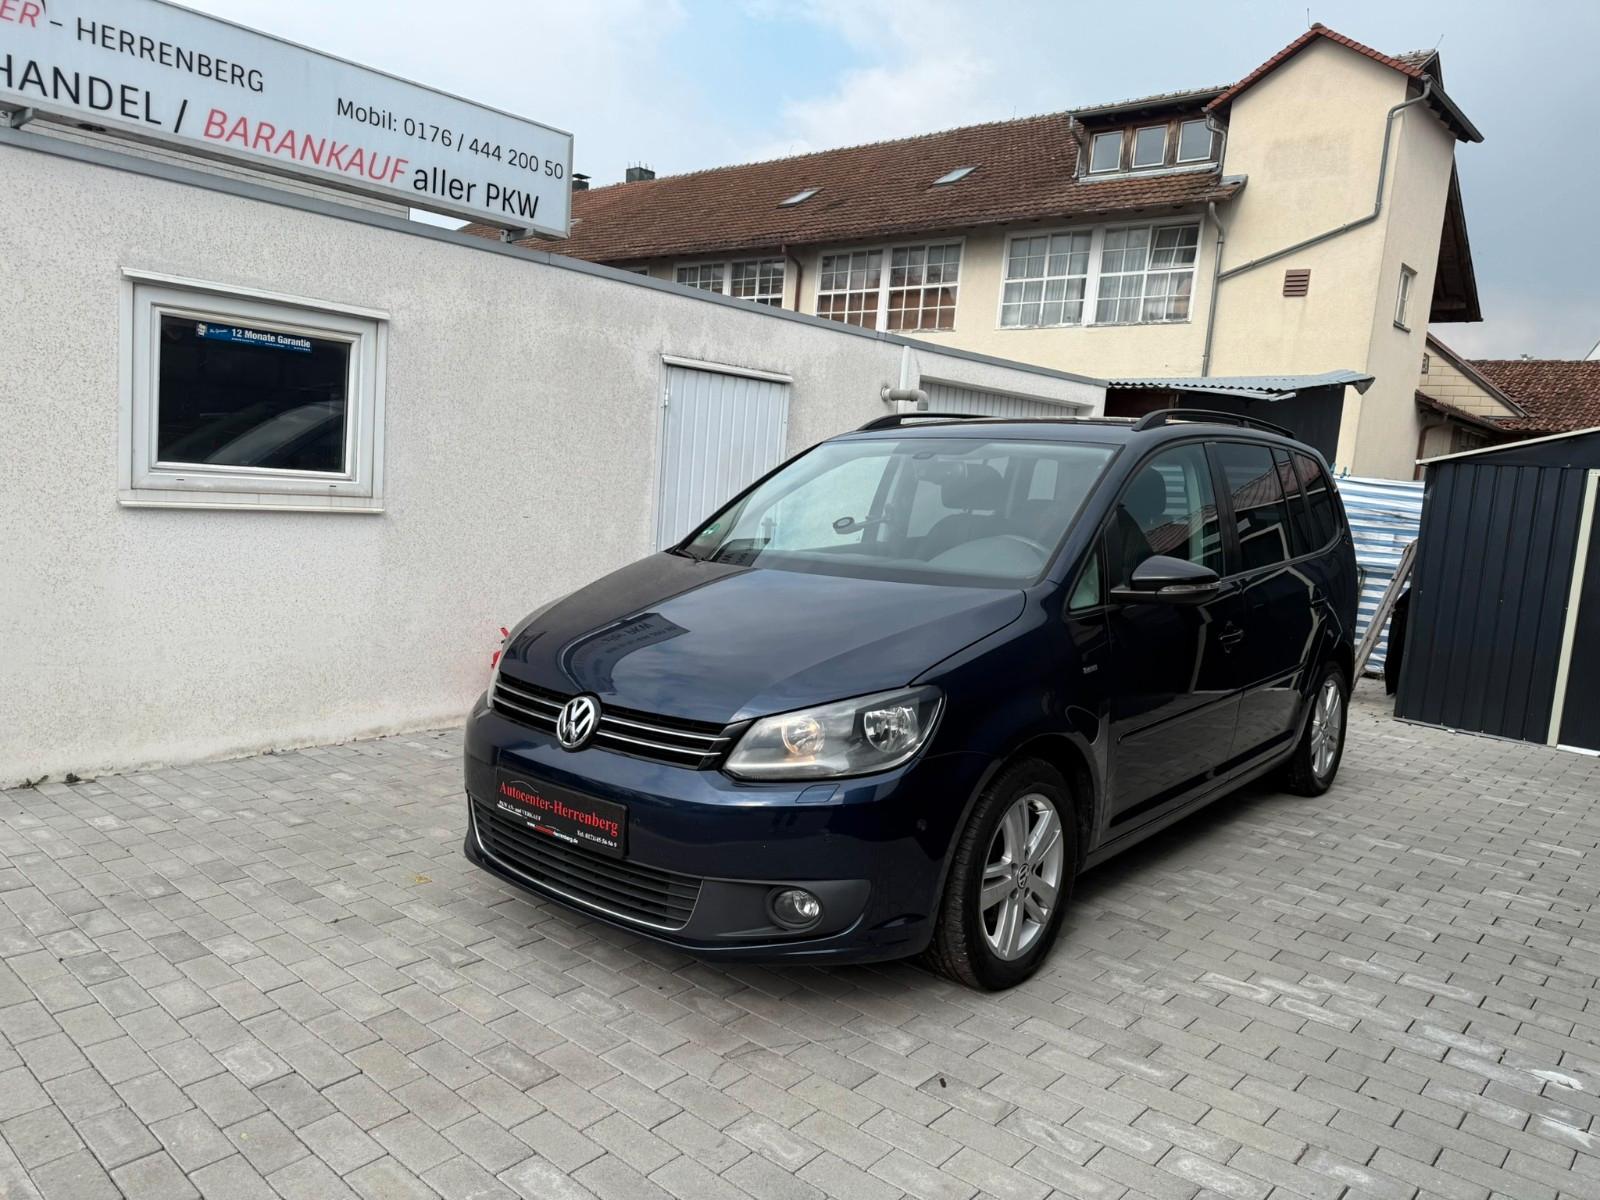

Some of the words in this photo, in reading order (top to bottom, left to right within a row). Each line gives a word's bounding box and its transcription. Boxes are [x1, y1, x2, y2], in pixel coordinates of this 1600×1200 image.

[77, 16, 264, 94] HERRENBERG
[203, 108, 409, 184] BARANKAUF
[413, 166, 477, 202] aller
[486, 182, 539, 219] PKW
[337, 97, 397, 132] Mobil:
[403, 118, 452, 147] 0176
[469, 138, 502, 162] 444
[508, 149, 539, 172] 200
[544, 162, 564, 180] 50
[231, 328, 243, 338] 12
[244, 330, 276, 343] Monate
[277, 335, 311, 348] Garantie
[499, 781, 619, 838] Autocenter-Herrenberg
